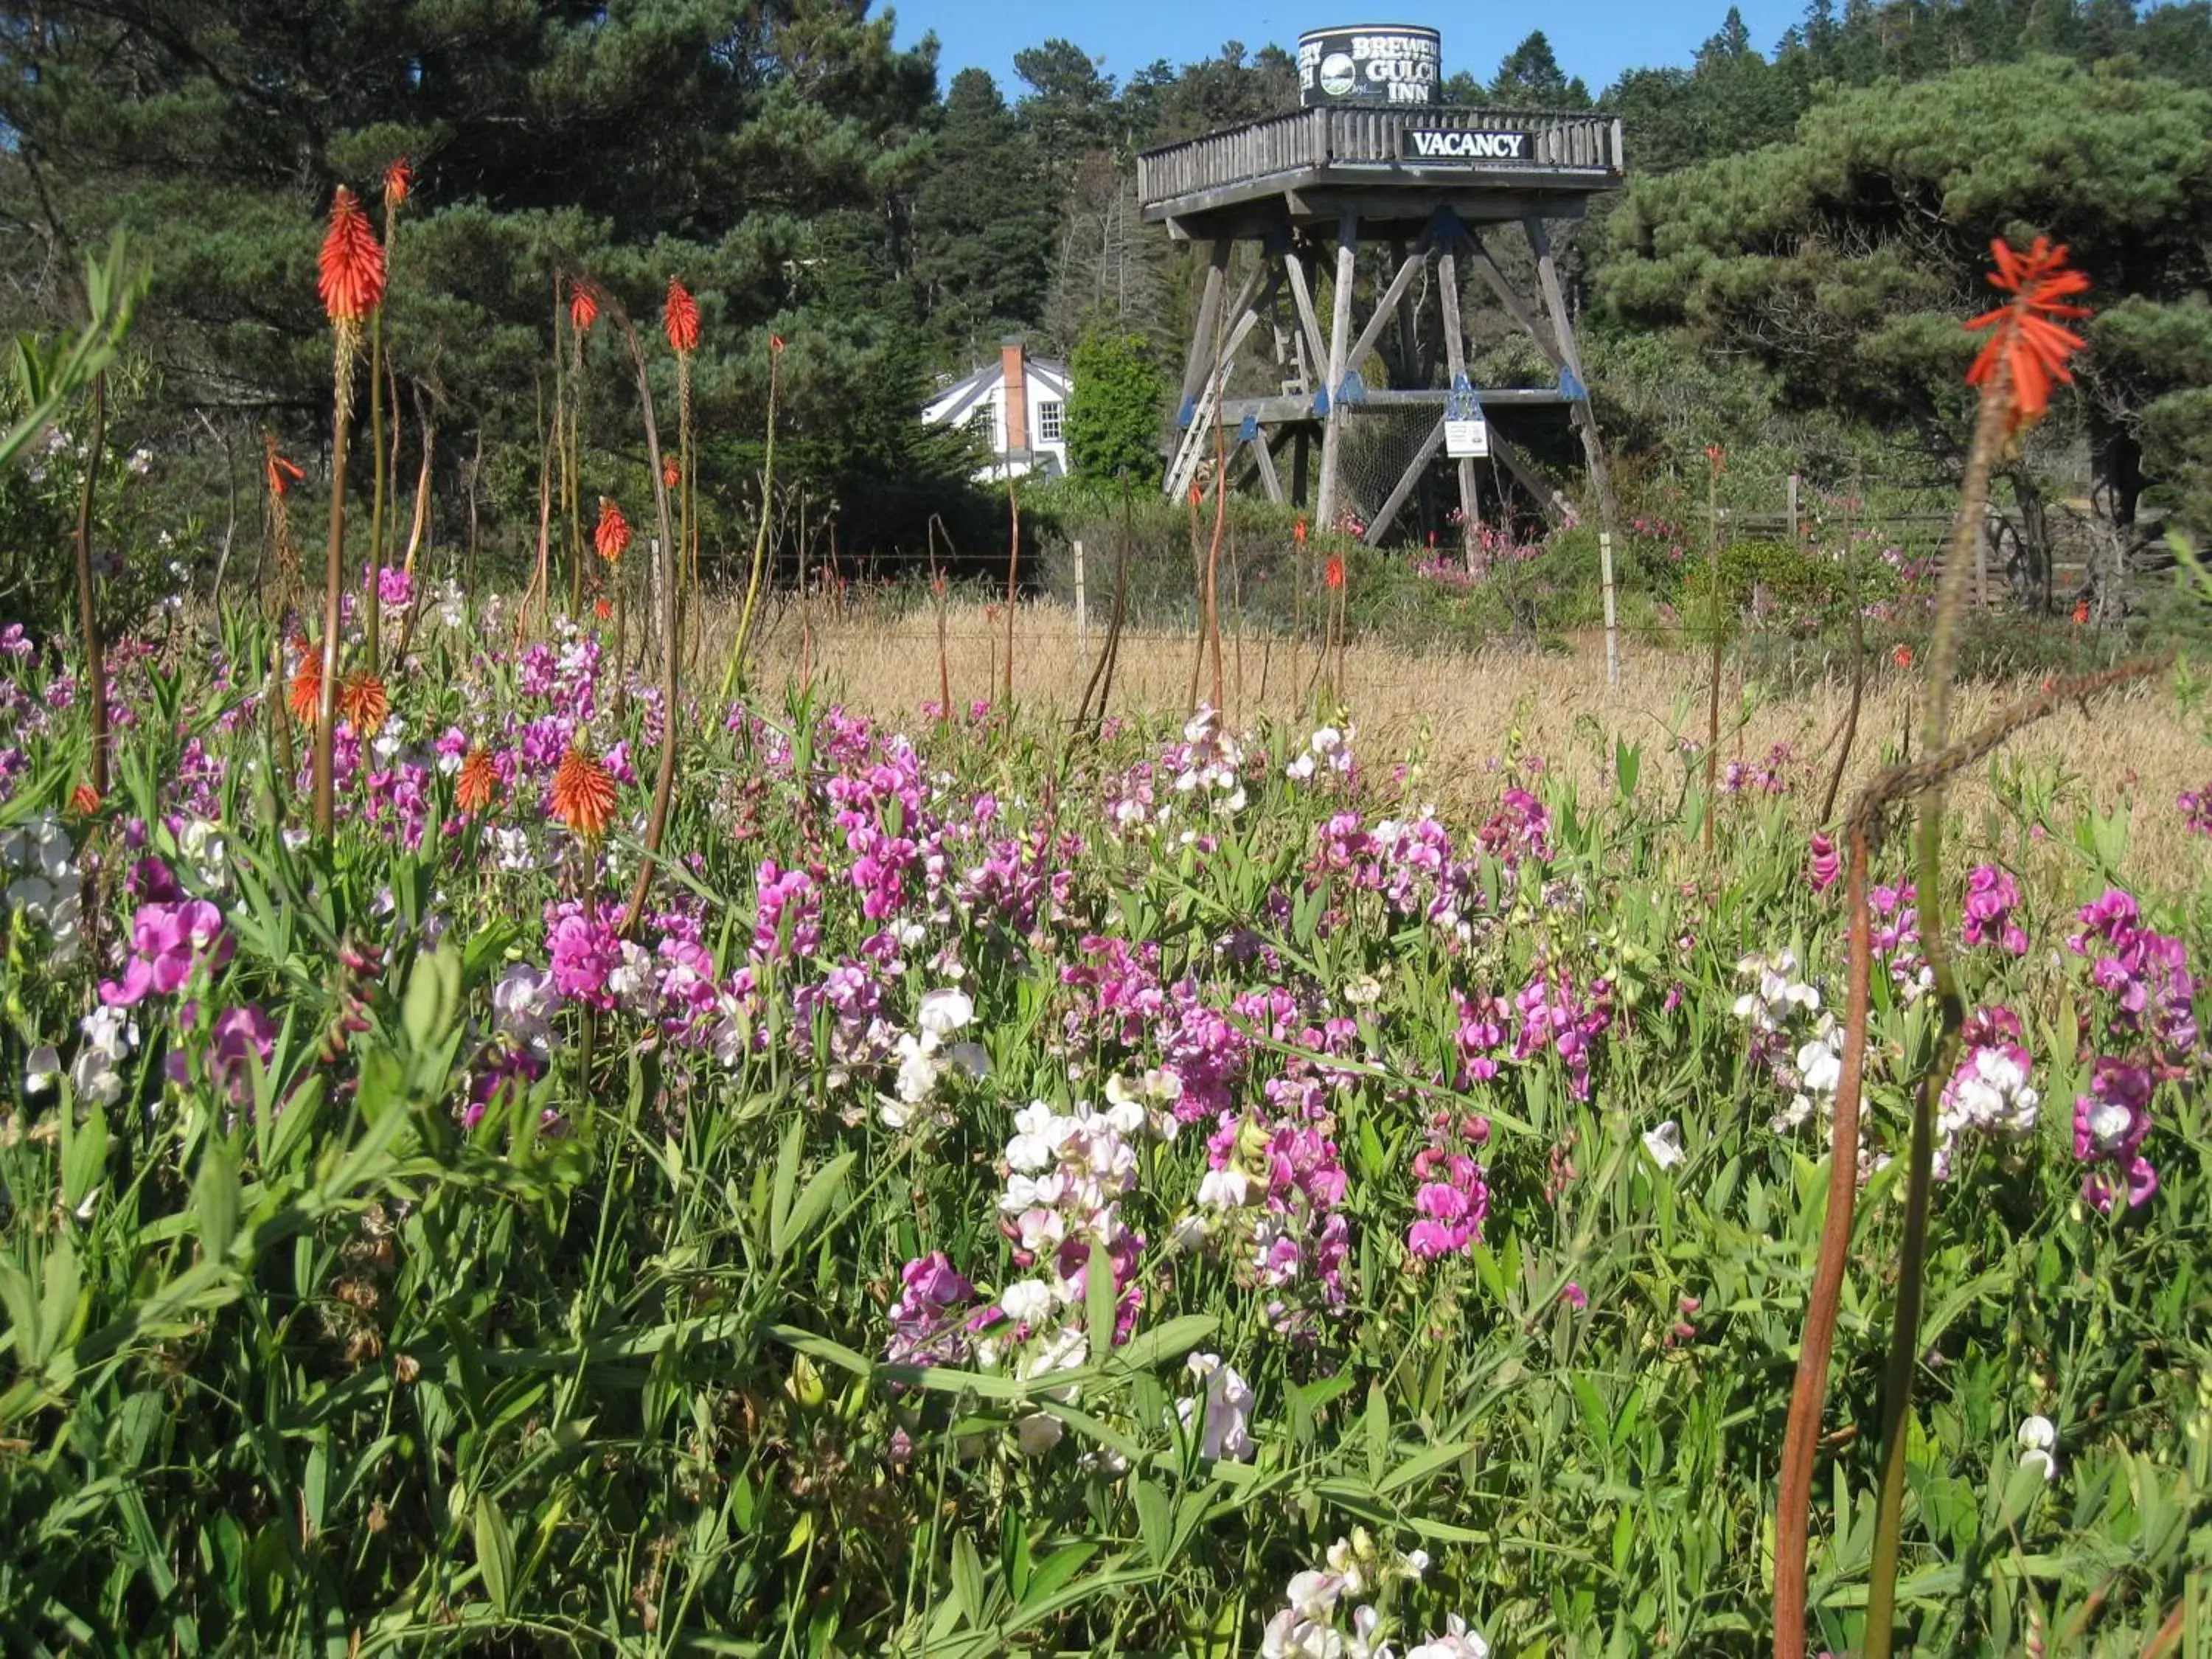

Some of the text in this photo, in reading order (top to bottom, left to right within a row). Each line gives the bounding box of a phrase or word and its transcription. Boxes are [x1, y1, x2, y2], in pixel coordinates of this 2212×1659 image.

[1365, 60, 1437, 84] GULCH
[1387, 82, 1429, 104] INN
[1413, 132, 1523, 157] VACANCY
